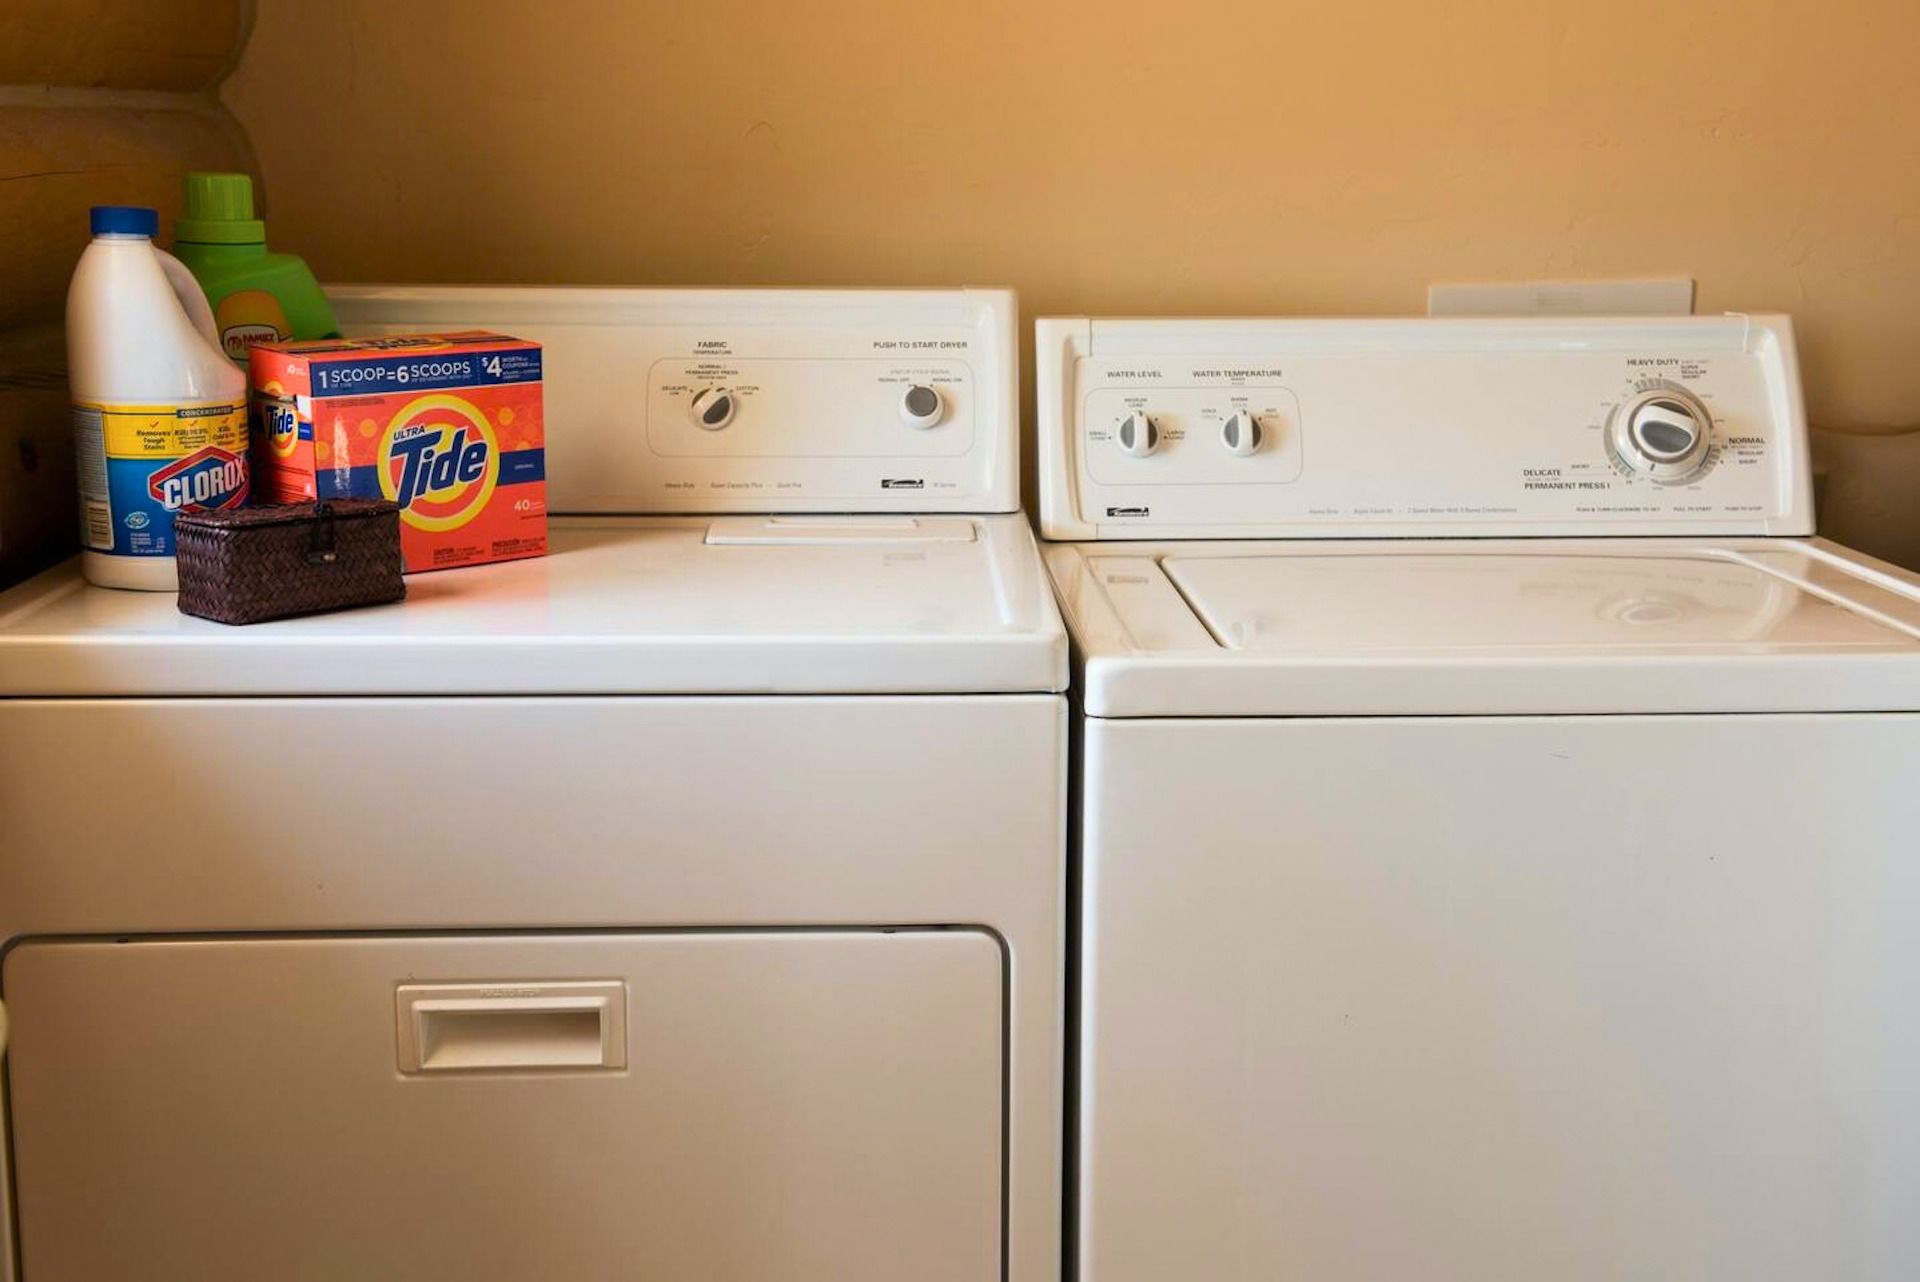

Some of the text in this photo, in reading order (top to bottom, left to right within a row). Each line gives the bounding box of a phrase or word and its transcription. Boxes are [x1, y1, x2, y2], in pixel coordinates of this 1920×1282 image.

[318, 371, 328, 389] 1
[410, 361, 471, 378] SCOOPS
[393, 424, 425, 440] ULTRA
[163, 456, 246, 509] CLOROX
[390, 426, 488, 511] Tide
[514, 499, 531, 512] 40
